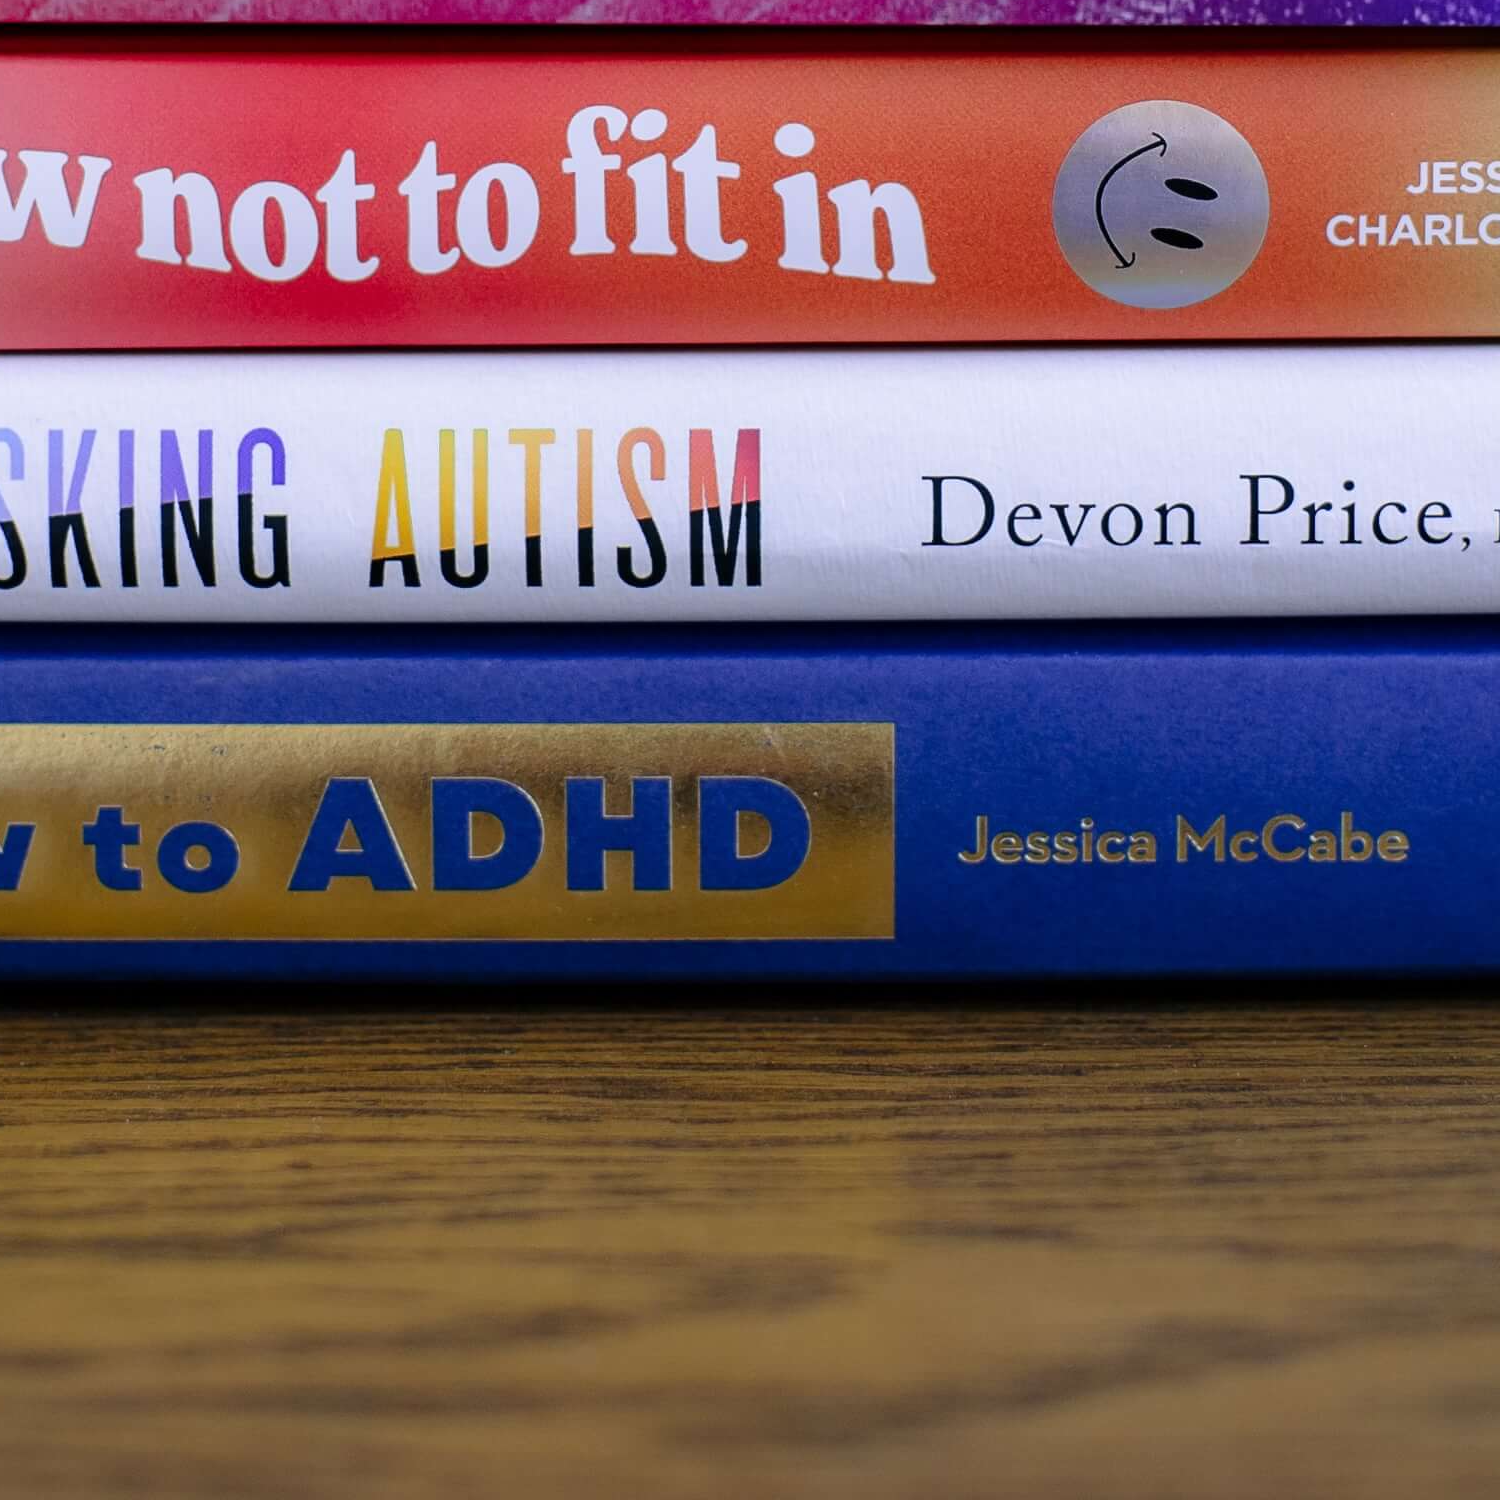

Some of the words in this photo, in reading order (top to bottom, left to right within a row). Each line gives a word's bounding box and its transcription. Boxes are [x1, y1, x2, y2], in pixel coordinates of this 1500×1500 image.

[132, 148, 380, 282] not
[397, 140, 540, 275] to
[561, 104, 748, 262] fit
[772, 122, 936, 285] in
[368, 429, 762, 589] AUTISM
[921, 475, 1202, 547] Devon
[1239, 474, 1471, 552] Price,
[82, 804, 242, 894] to
[288, 776, 813, 892] ADHD
[957, 815, 1157, 864] Jessica
[1176, 811, 1410, 863] McCabe
